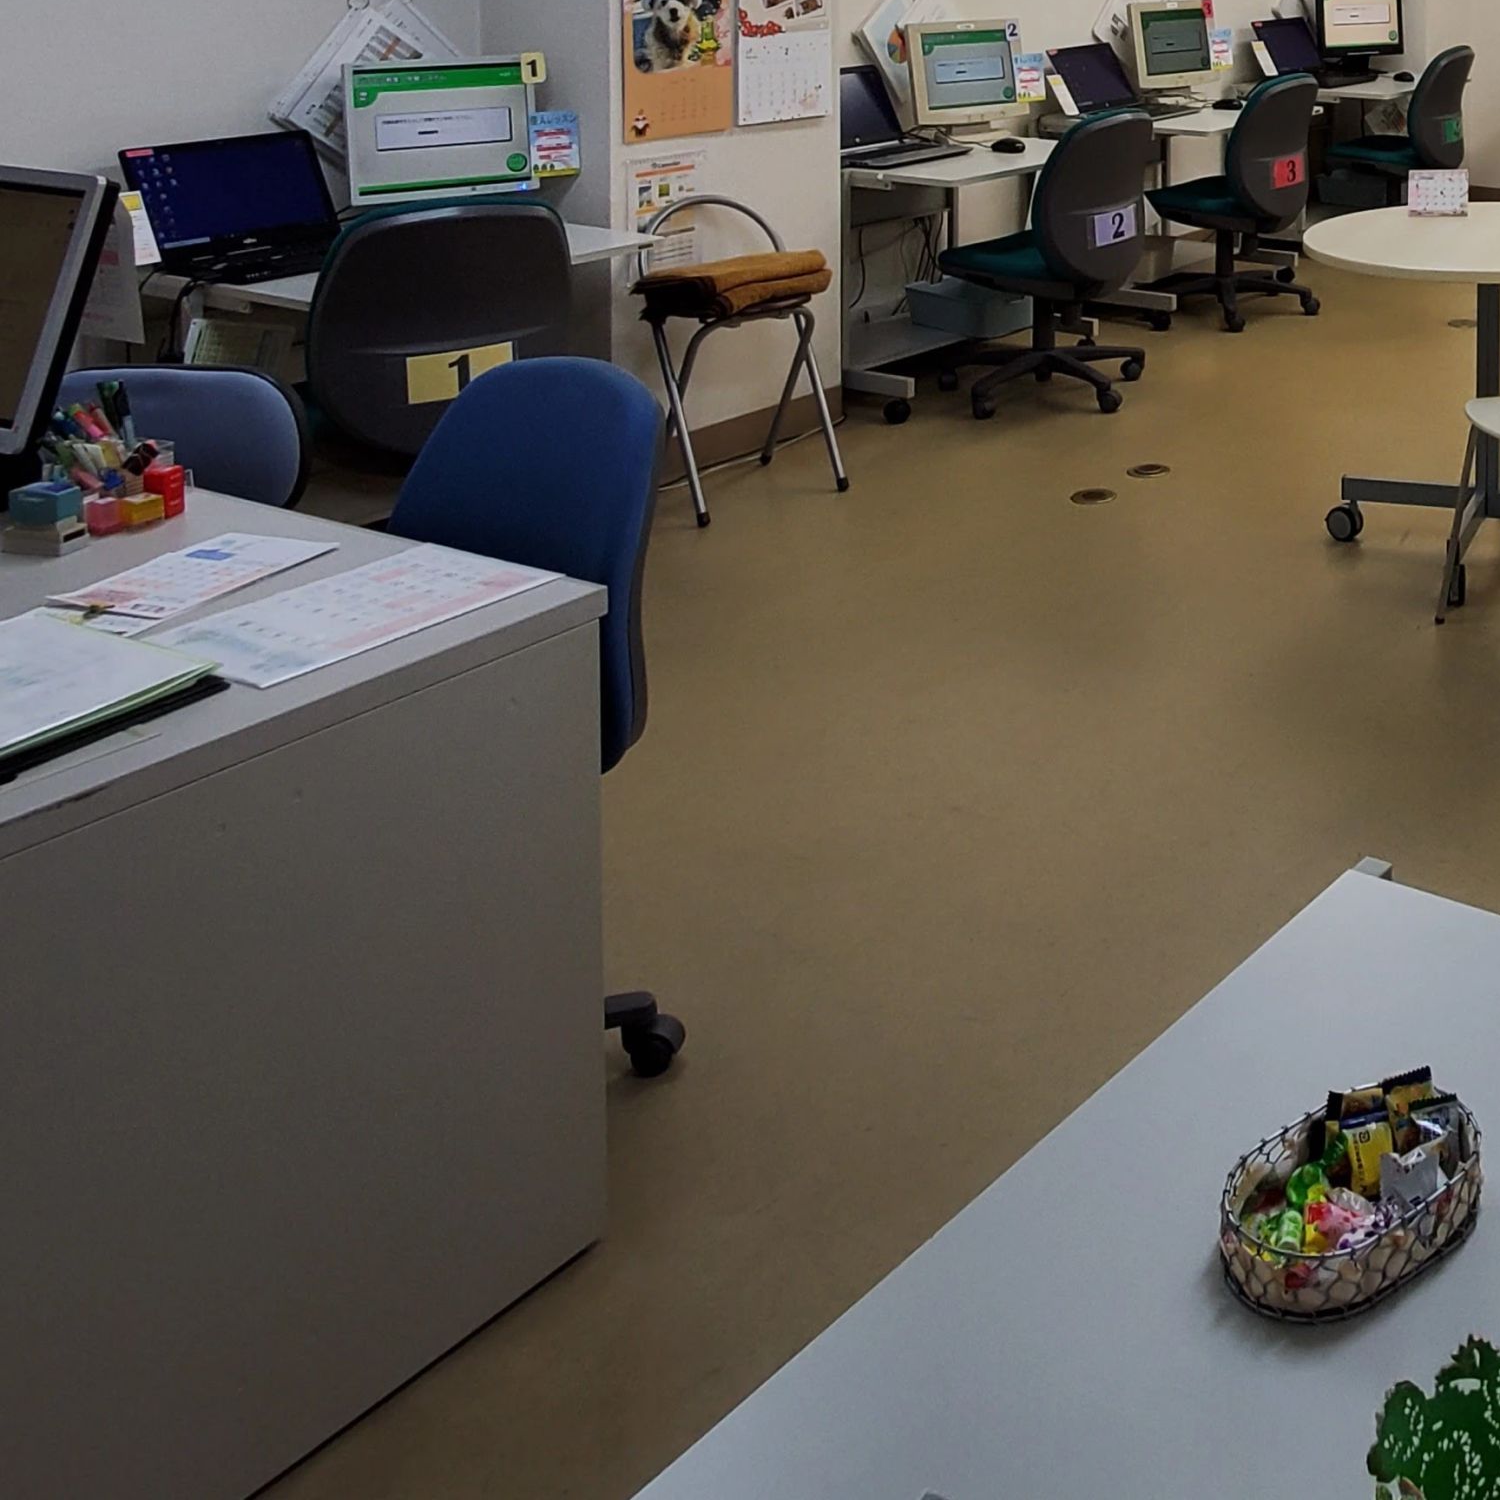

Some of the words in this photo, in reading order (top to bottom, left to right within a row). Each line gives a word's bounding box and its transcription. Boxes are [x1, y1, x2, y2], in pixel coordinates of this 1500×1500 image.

[1204, 2, 1211, 15] 3
[1007, 23, 1018, 37] 2
[525, 59, 538, 78] 1
[1287, 160, 1297, 183] 3
[1111, 213, 1125, 239] 2
[448, 354, 471, 394] 1
